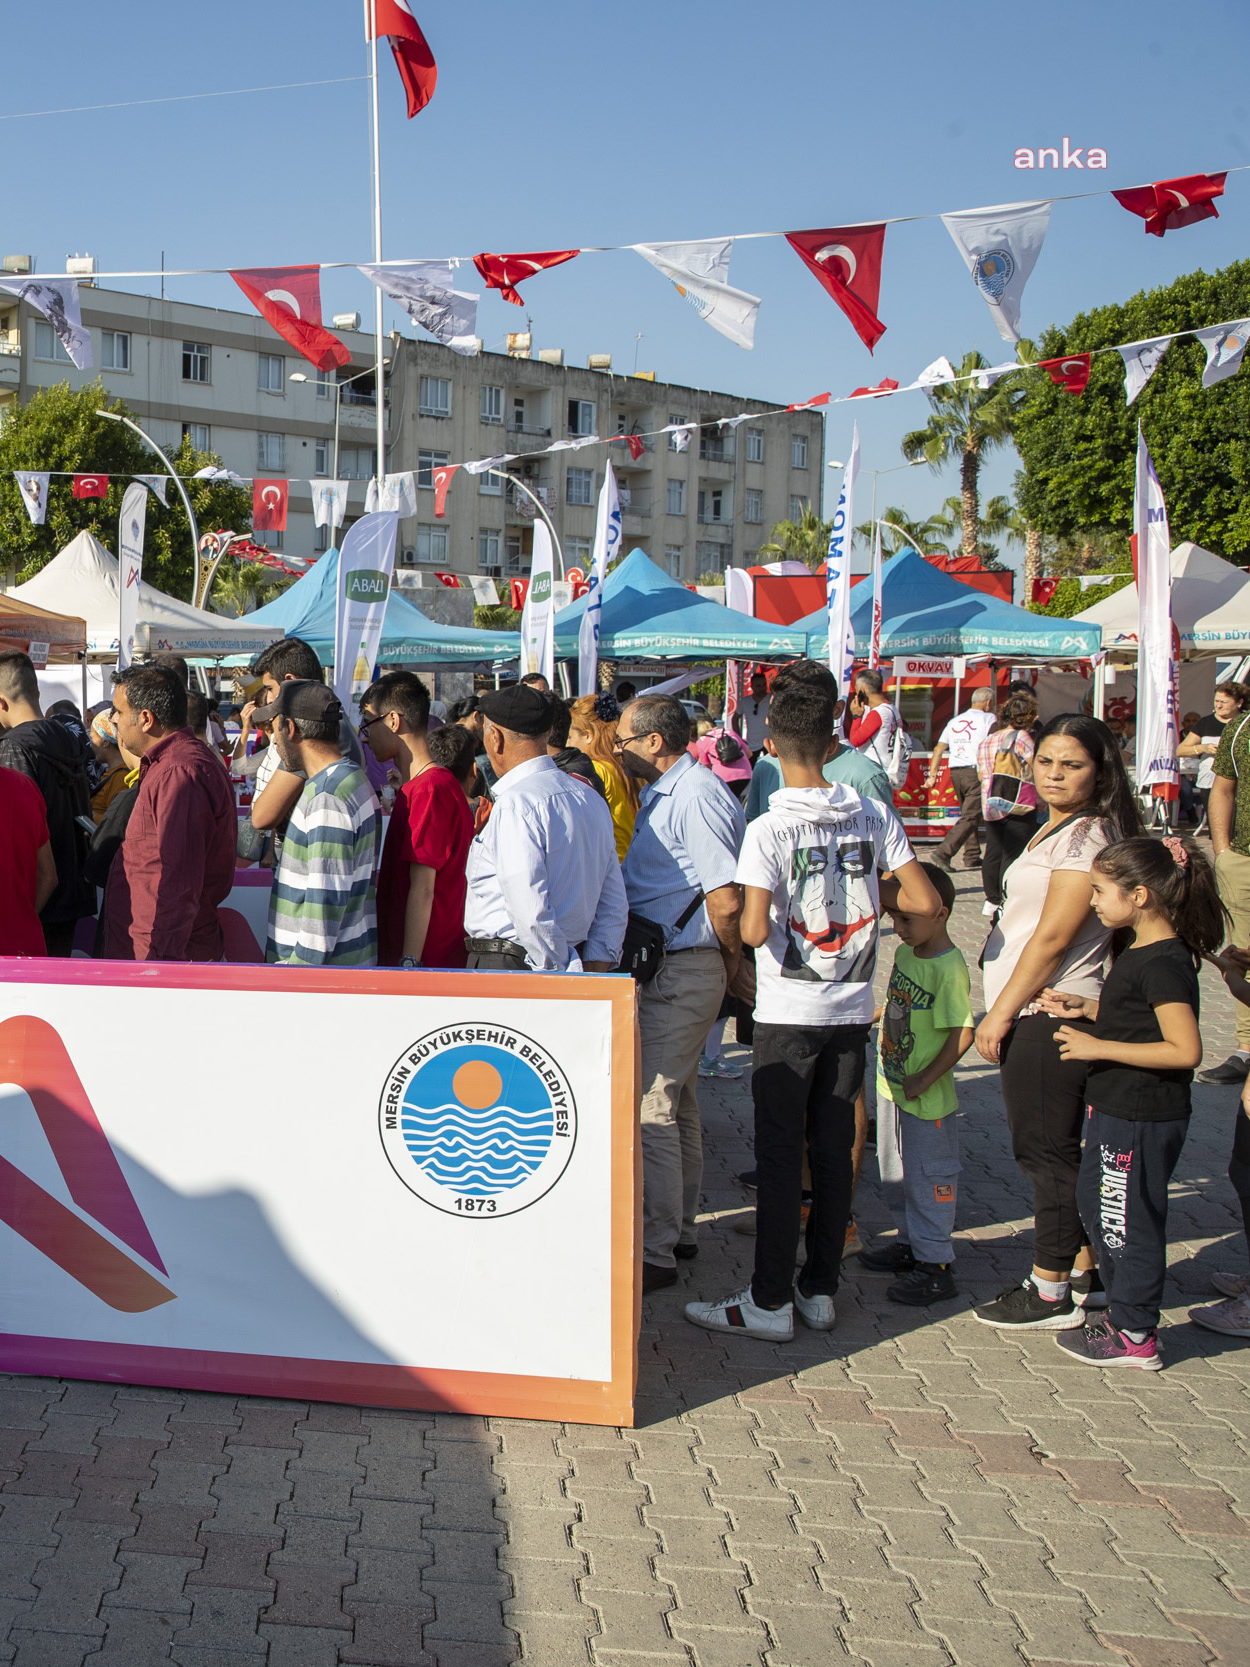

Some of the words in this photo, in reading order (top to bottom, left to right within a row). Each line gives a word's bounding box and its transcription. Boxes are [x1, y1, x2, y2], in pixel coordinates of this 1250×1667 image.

[634, 634, 700, 649] BÜYÜKŞEHİR
[702, 637, 758, 648] BELEDİYESİ
[922, 633, 989, 646] BÜYÜKŞEHİR
[991, 634, 1050, 648] BELEDİYESİ
[383, 643, 438, 657] BÜYÜKŞEHİR
[905, 660, 954, 674] OKYAY
[384, 1065, 412, 1130] MERSİN
[407, 1028, 518, 1067] BÜYÜKŞEHİR
[518, 1044, 571, 1138] BELEDİYESİ
[453, 1197, 498, 1213] 1873
[1100, 1164, 1128, 1236] JUSTICE
